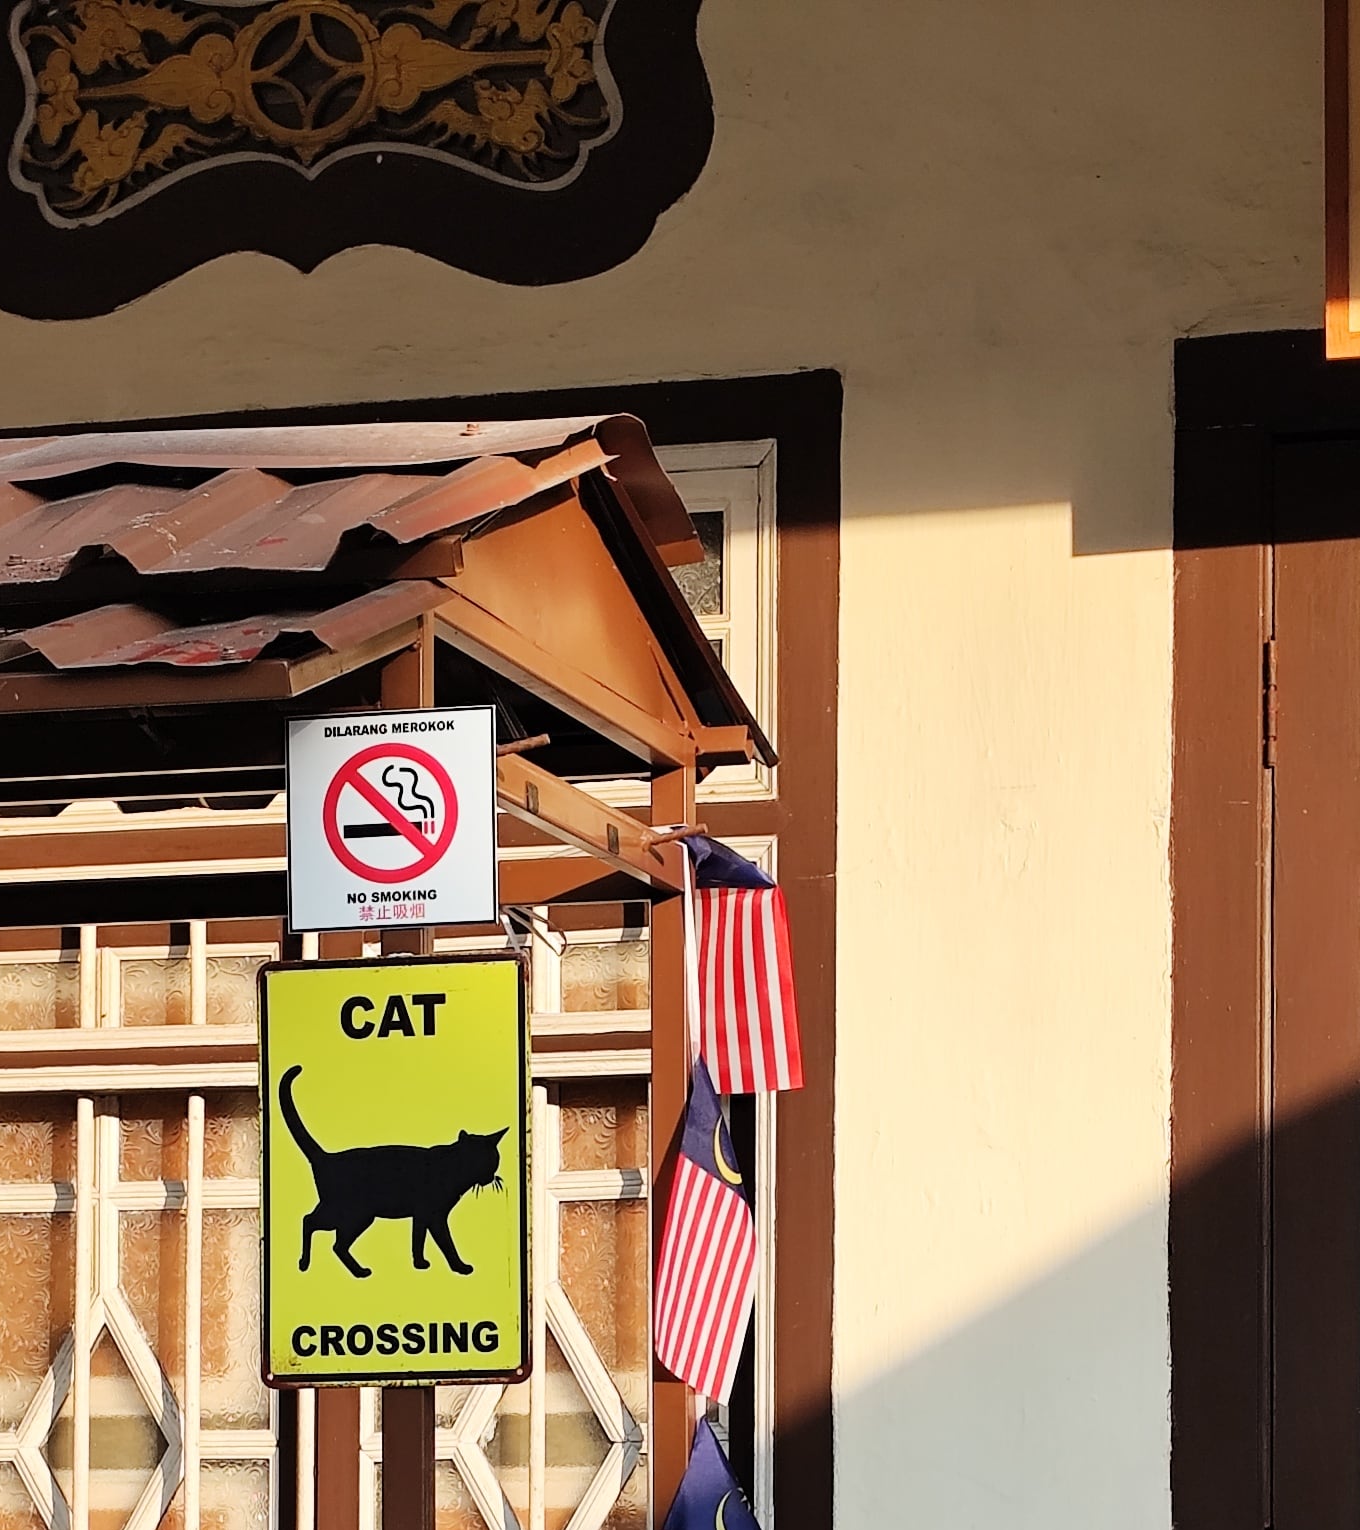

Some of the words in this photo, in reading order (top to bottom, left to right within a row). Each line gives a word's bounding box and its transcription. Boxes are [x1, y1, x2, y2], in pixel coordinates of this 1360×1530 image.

[324, 724, 387, 738] DILARANG
[391, 720, 455, 734] MEROKOK
[347, 892, 367, 904] NO
[371, 889, 437, 903] SMOKING
[358, 903, 425, 922] 禁止吸烟
[340, 993, 446, 1039] CAT
[291, 1321, 500, 1357] CROSSING
